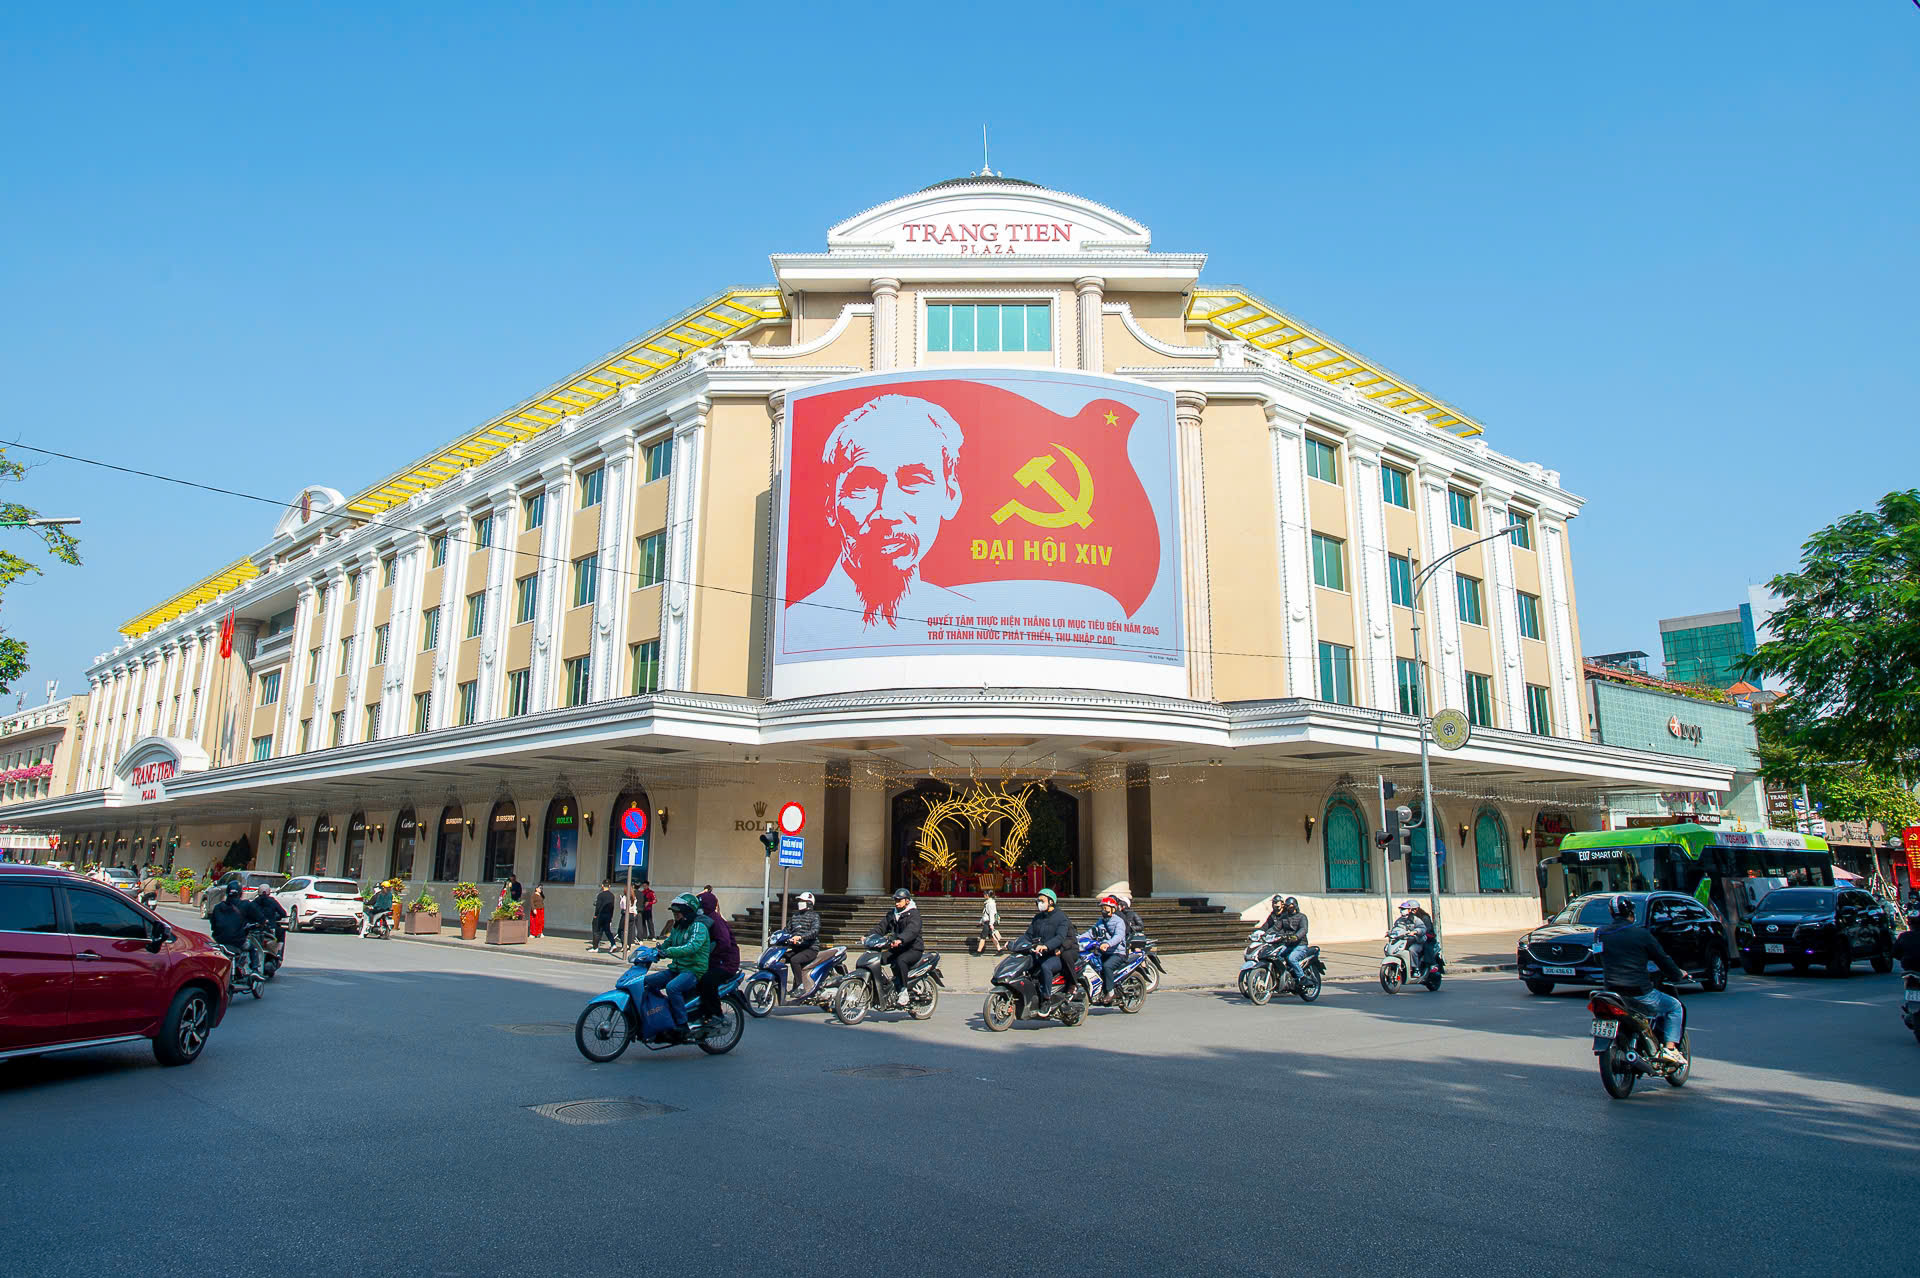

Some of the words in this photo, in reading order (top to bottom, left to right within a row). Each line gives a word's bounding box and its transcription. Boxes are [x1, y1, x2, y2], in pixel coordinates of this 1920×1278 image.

[903, 224, 999, 244] TRANG
[1005, 224, 1073, 242] TIEN
[961, 244, 1016, 254] PLAZA
[970, 539, 1013, 565] ĐẠI
[1024, 536, 1066, 567] HỘI
[1075, 543, 1113, 566] XIV
[927, 613, 953, 627] QUYẾT
[955, 614, 974, 626] TÂM
[976, 615, 999, 628] THỰC
[1000, 614, 1021, 628] HIỆN
[1052, 618, 1066, 630] LỢI
[1068, 619, 1086, 631] MỤC
[1088, 619, 1104, 630] TIÊU
[1107, 619, 1122, 632] ĐẾN
[1124, 622, 1141, 634] NĂM
[1143, 625, 1160, 636] 2045
[928, 627, 944, 640] TRỞ
[946, 628, 974, 640] THÀNH
[976, 628, 1000, 640] NƯỚC
[1003, 628, 1025, 641] PHÁT
[1056, 632, 1071, 643] THU
[1073, 632, 1095, 645] NHẬP
[132, 763, 157, 788] TRANG
[157, 759, 177, 782] TIEN
[142, 788, 157, 801] PLAZA
[556, 816, 573, 825] ROLEX
[201, 840, 231, 848] GUCC
[1725, 834, 1749, 845] TOSHIBA
[1579, 850, 1590, 861] E07
[1591, 850, 1611, 859] SMART
[1611, 850, 1623, 859] CITY
